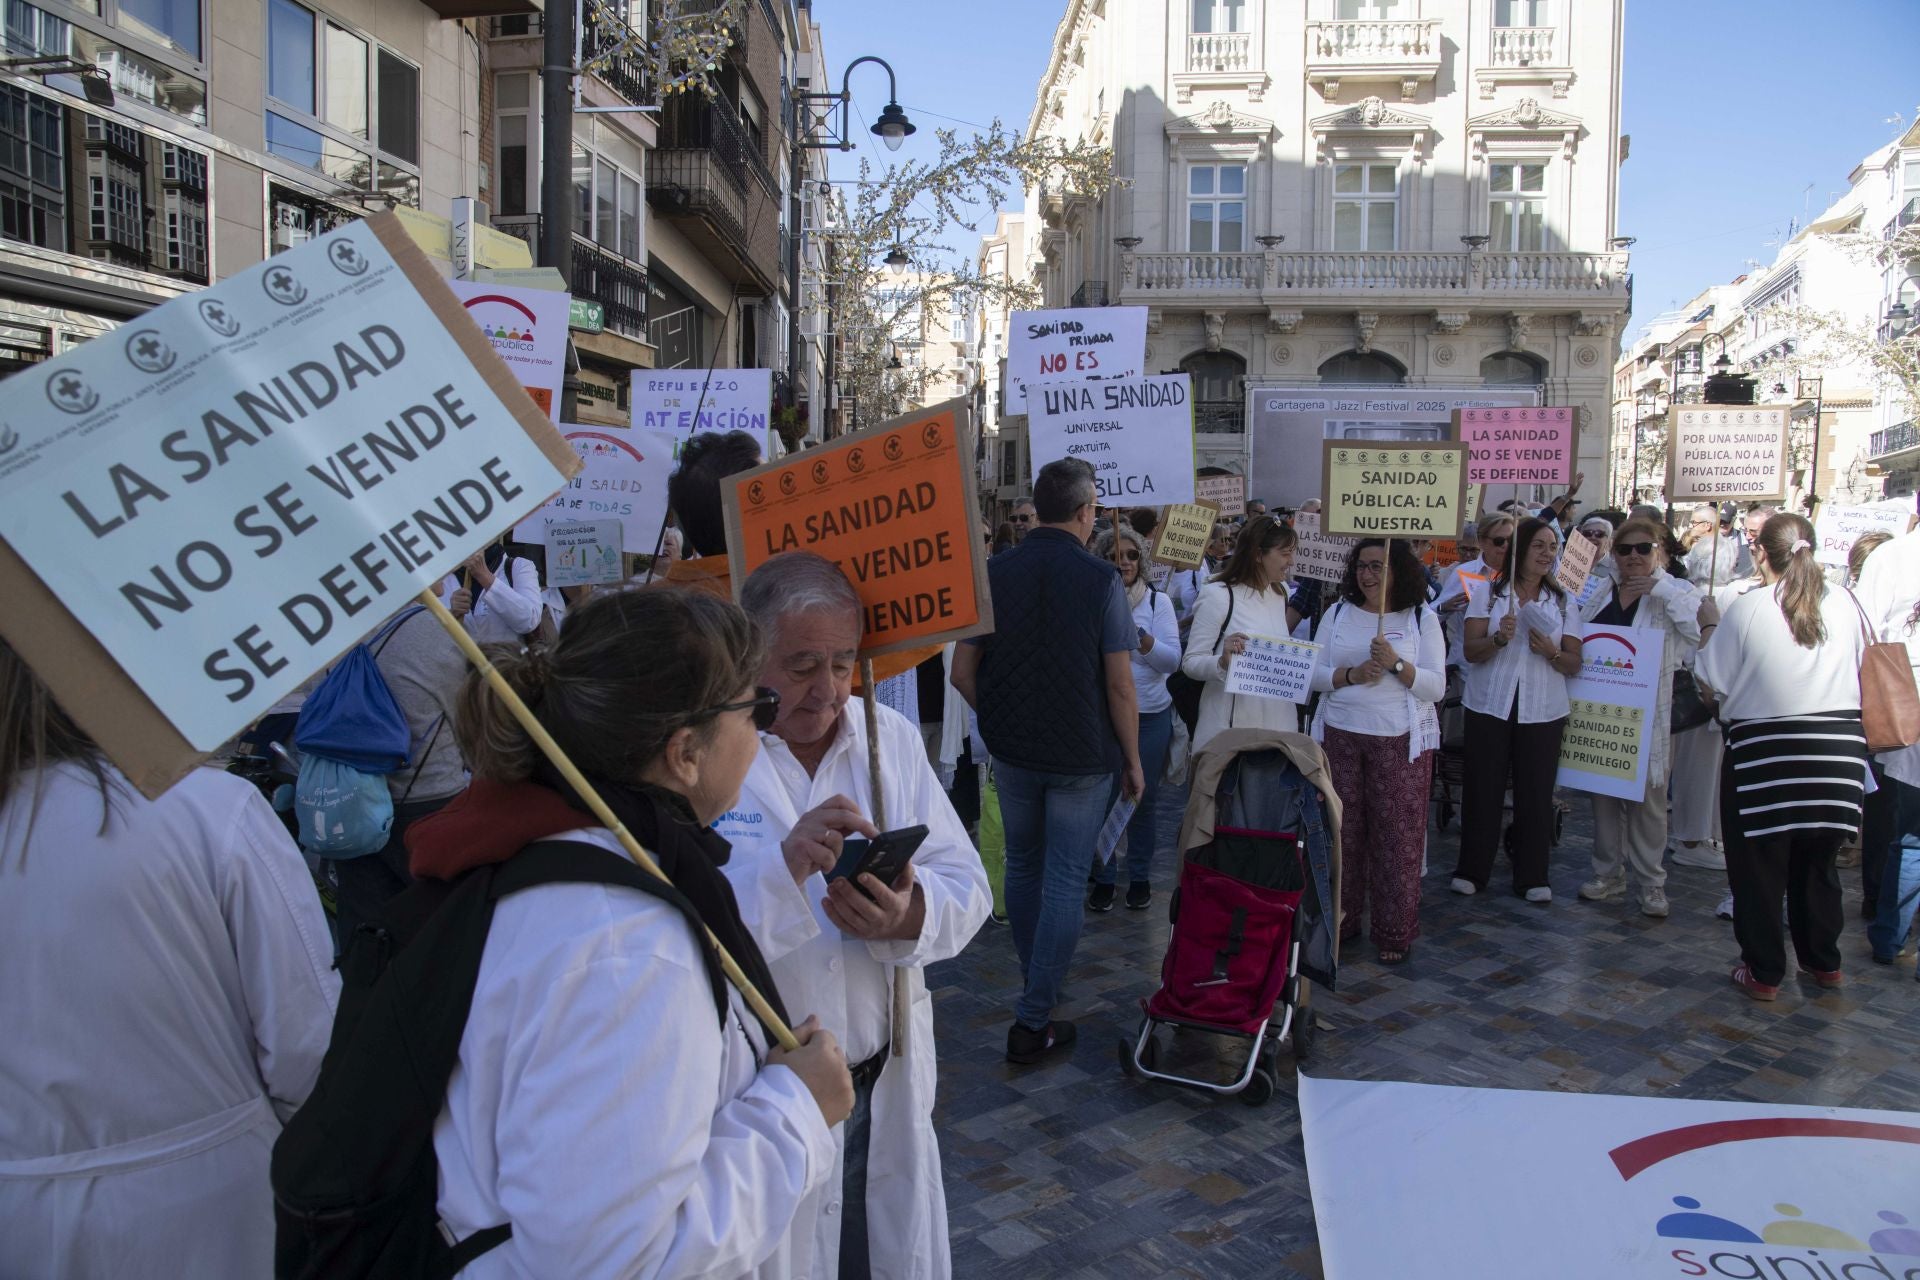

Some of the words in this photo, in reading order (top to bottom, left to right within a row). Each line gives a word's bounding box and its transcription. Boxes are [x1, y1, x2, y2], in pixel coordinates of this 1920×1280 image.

[588, 322, 600, 330] DEA
[1040, 353, 1067, 374] NO
[1076, 351, 1099, 371] ES
[648, 380, 739, 392] REFUERZO
[664, 398, 681, 407] DE
[1044, 388, 1095, 415] UNA
[1269, 400, 1325, 412] Cartagena
[1334, 401, 1359, 412] Jazz
[1365, 401, 1410, 412] Festival
[1416, 402, 1446, 412] 2025
[61, 462, 170, 539] LA
[160, 323, 406, 484] SANIDAD
[1472, 430, 1490, 441] LA
[1494, 430, 1559, 441] SANIDAD
[1683, 434, 1706, 444] POR
[1709, 434, 1731, 444] UNA
[1733, 434, 1778, 444] SANIDAD
[1468, 450, 1490, 460] NO
[1495, 449, 1511, 460] SE
[1515, 449, 1562, 460] VENDE
[1685, 448, 1732, 460] PÚBLICA.
[1736, 451, 1751, 460] NO
[1754, 451, 1761, 459] A
[1763, 450, 1774, 459] LA
[1470, 468, 1486, 480] SE
[1490, 468, 1559, 480] DEFIENDE
[1682, 464, 1760, 476] PRIVATIZACIÓN
[1763, 466, 1775, 475] DE
[1361, 471, 1437, 485] SANIDAD
[590, 479, 642, 493] SALUD
[1206, 488, 1231, 496] SANIDAD
[1692, 483, 1712, 492] LOS
[1714, 482, 1764, 492] SERVICIOS
[118, 540, 235, 630] NO
[234, 482, 318, 558] SE
[306, 383, 477, 502] VENDE
[556, 498, 565, 507] LA
[570, 500, 583, 509] DE
[588, 501, 632, 515] TODAS
[1341, 490, 1420, 508] PÚBLICA:
[1426, 495, 1448, 509] LA
[765, 523, 798, 555] LA
[805, 482, 936, 544] SANIDAD
[1172, 516, 1180, 526] LA
[1181, 519, 1207, 532] SANIDAD
[1353, 516, 1433, 530] NUESTRA
[1166, 531, 1177, 540] NO
[1177, 534, 1185, 542] SE
[1186, 536, 1204, 547] VENDE
[1300, 530, 1310, 540] LA
[852, 531, 952, 582] VENDE
[1162, 546, 1170, 556] SE
[1170, 548, 1199, 561] DEFIENDE
[1296, 547, 1309, 557] NO
[1312, 550, 1322, 559] SE
[1296, 563, 1306, 573] SE
[203, 624, 290, 702] SE
[278, 456, 524, 646] DEFIENDE
[1254, 653, 1272, 662] UNA
[1274, 657, 1310, 670] SANIDAD
[1274, 668, 1286, 676] NO
[1234, 672, 1292, 688] PRIVATIZACIÓN
[1254, 686, 1294, 698] SERVICIOS
[1573, 720, 1620, 735] SANIDAD
[1623, 727, 1635, 737] ES
[1570, 735, 1618, 751] DERECHO
[1621, 744, 1638, 754] NO
[1573, 752, 1630, 770] PRIVILEGIO
